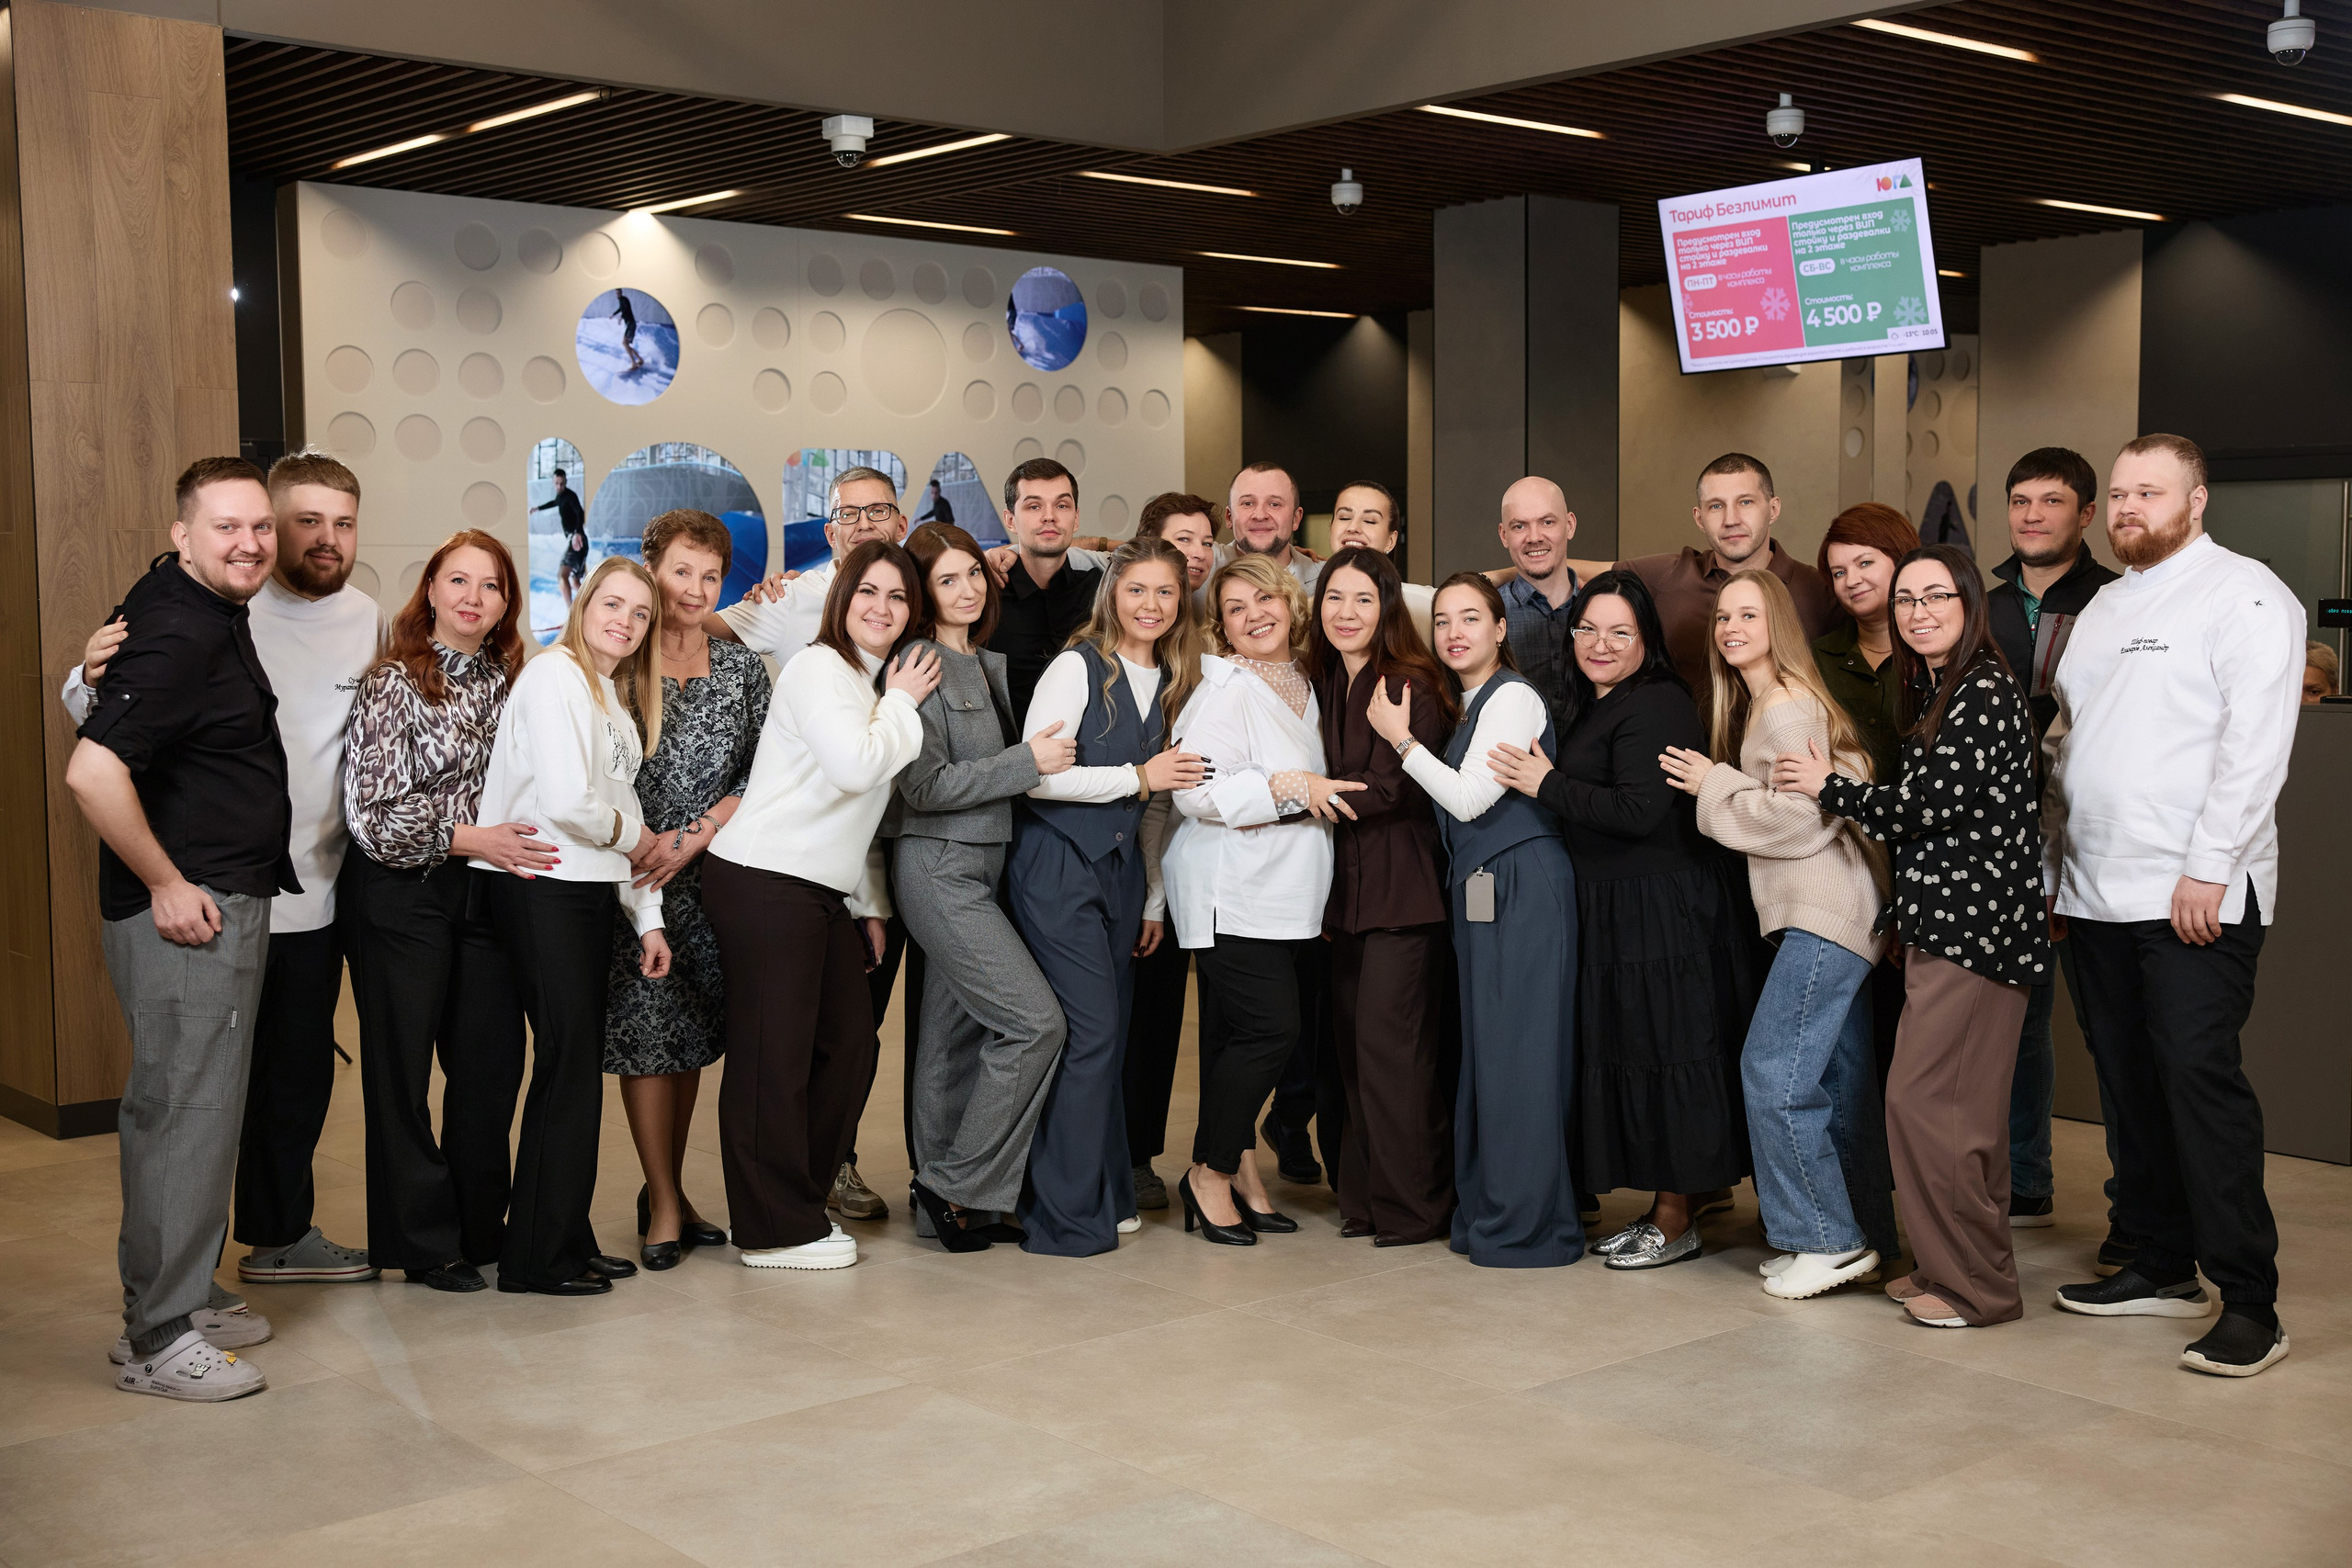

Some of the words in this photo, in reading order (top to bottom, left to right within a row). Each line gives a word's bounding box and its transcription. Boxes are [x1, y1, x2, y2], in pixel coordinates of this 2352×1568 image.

[1668, 204, 1714, 224] Тариф
[1716, 194, 1797, 217] Безлимит
[1792, 214, 1860, 231] Предусмотрен
[1861, 210, 1883, 220] вход
[1792, 228, 1826, 239] только
[1827, 223, 1854, 234] через
[1855, 219, 1875, 230] ВИП
[1677, 231, 1740, 247] Предусмотрен
[1741, 229, 1761, 238] вход
[1678, 244, 1710, 254] только
[1711, 241, 1735, 251] через
[1736, 237, 1754, 247] ВИП
[1793, 235, 1828, 247] стойку
[1837, 227, 1891, 242] раздевалки
[1679, 252, 1711, 263] стойку
[1719, 244, 1768, 258] раздевалки
[1794, 247, 1806, 255] на
[1807, 245, 1814, 254] 2
[1815, 242, 1846, 254] этаже
[1691, 261, 1698, 269] 2
[1699, 258, 1727, 268] этаже
[1803, 262, 1832, 273] СБ-ВС
[1687, 276, 1714, 288] ПН-ПТ
[1806, 309, 1822, 328] 4
[1824, 303, 1863, 327] 500
[1690, 322, 1703, 342] 3
[1705, 318, 1742, 340] 500
[1922, 328, 1939, 336] 10:05
[124, 1375, 136, 1385] AIR
